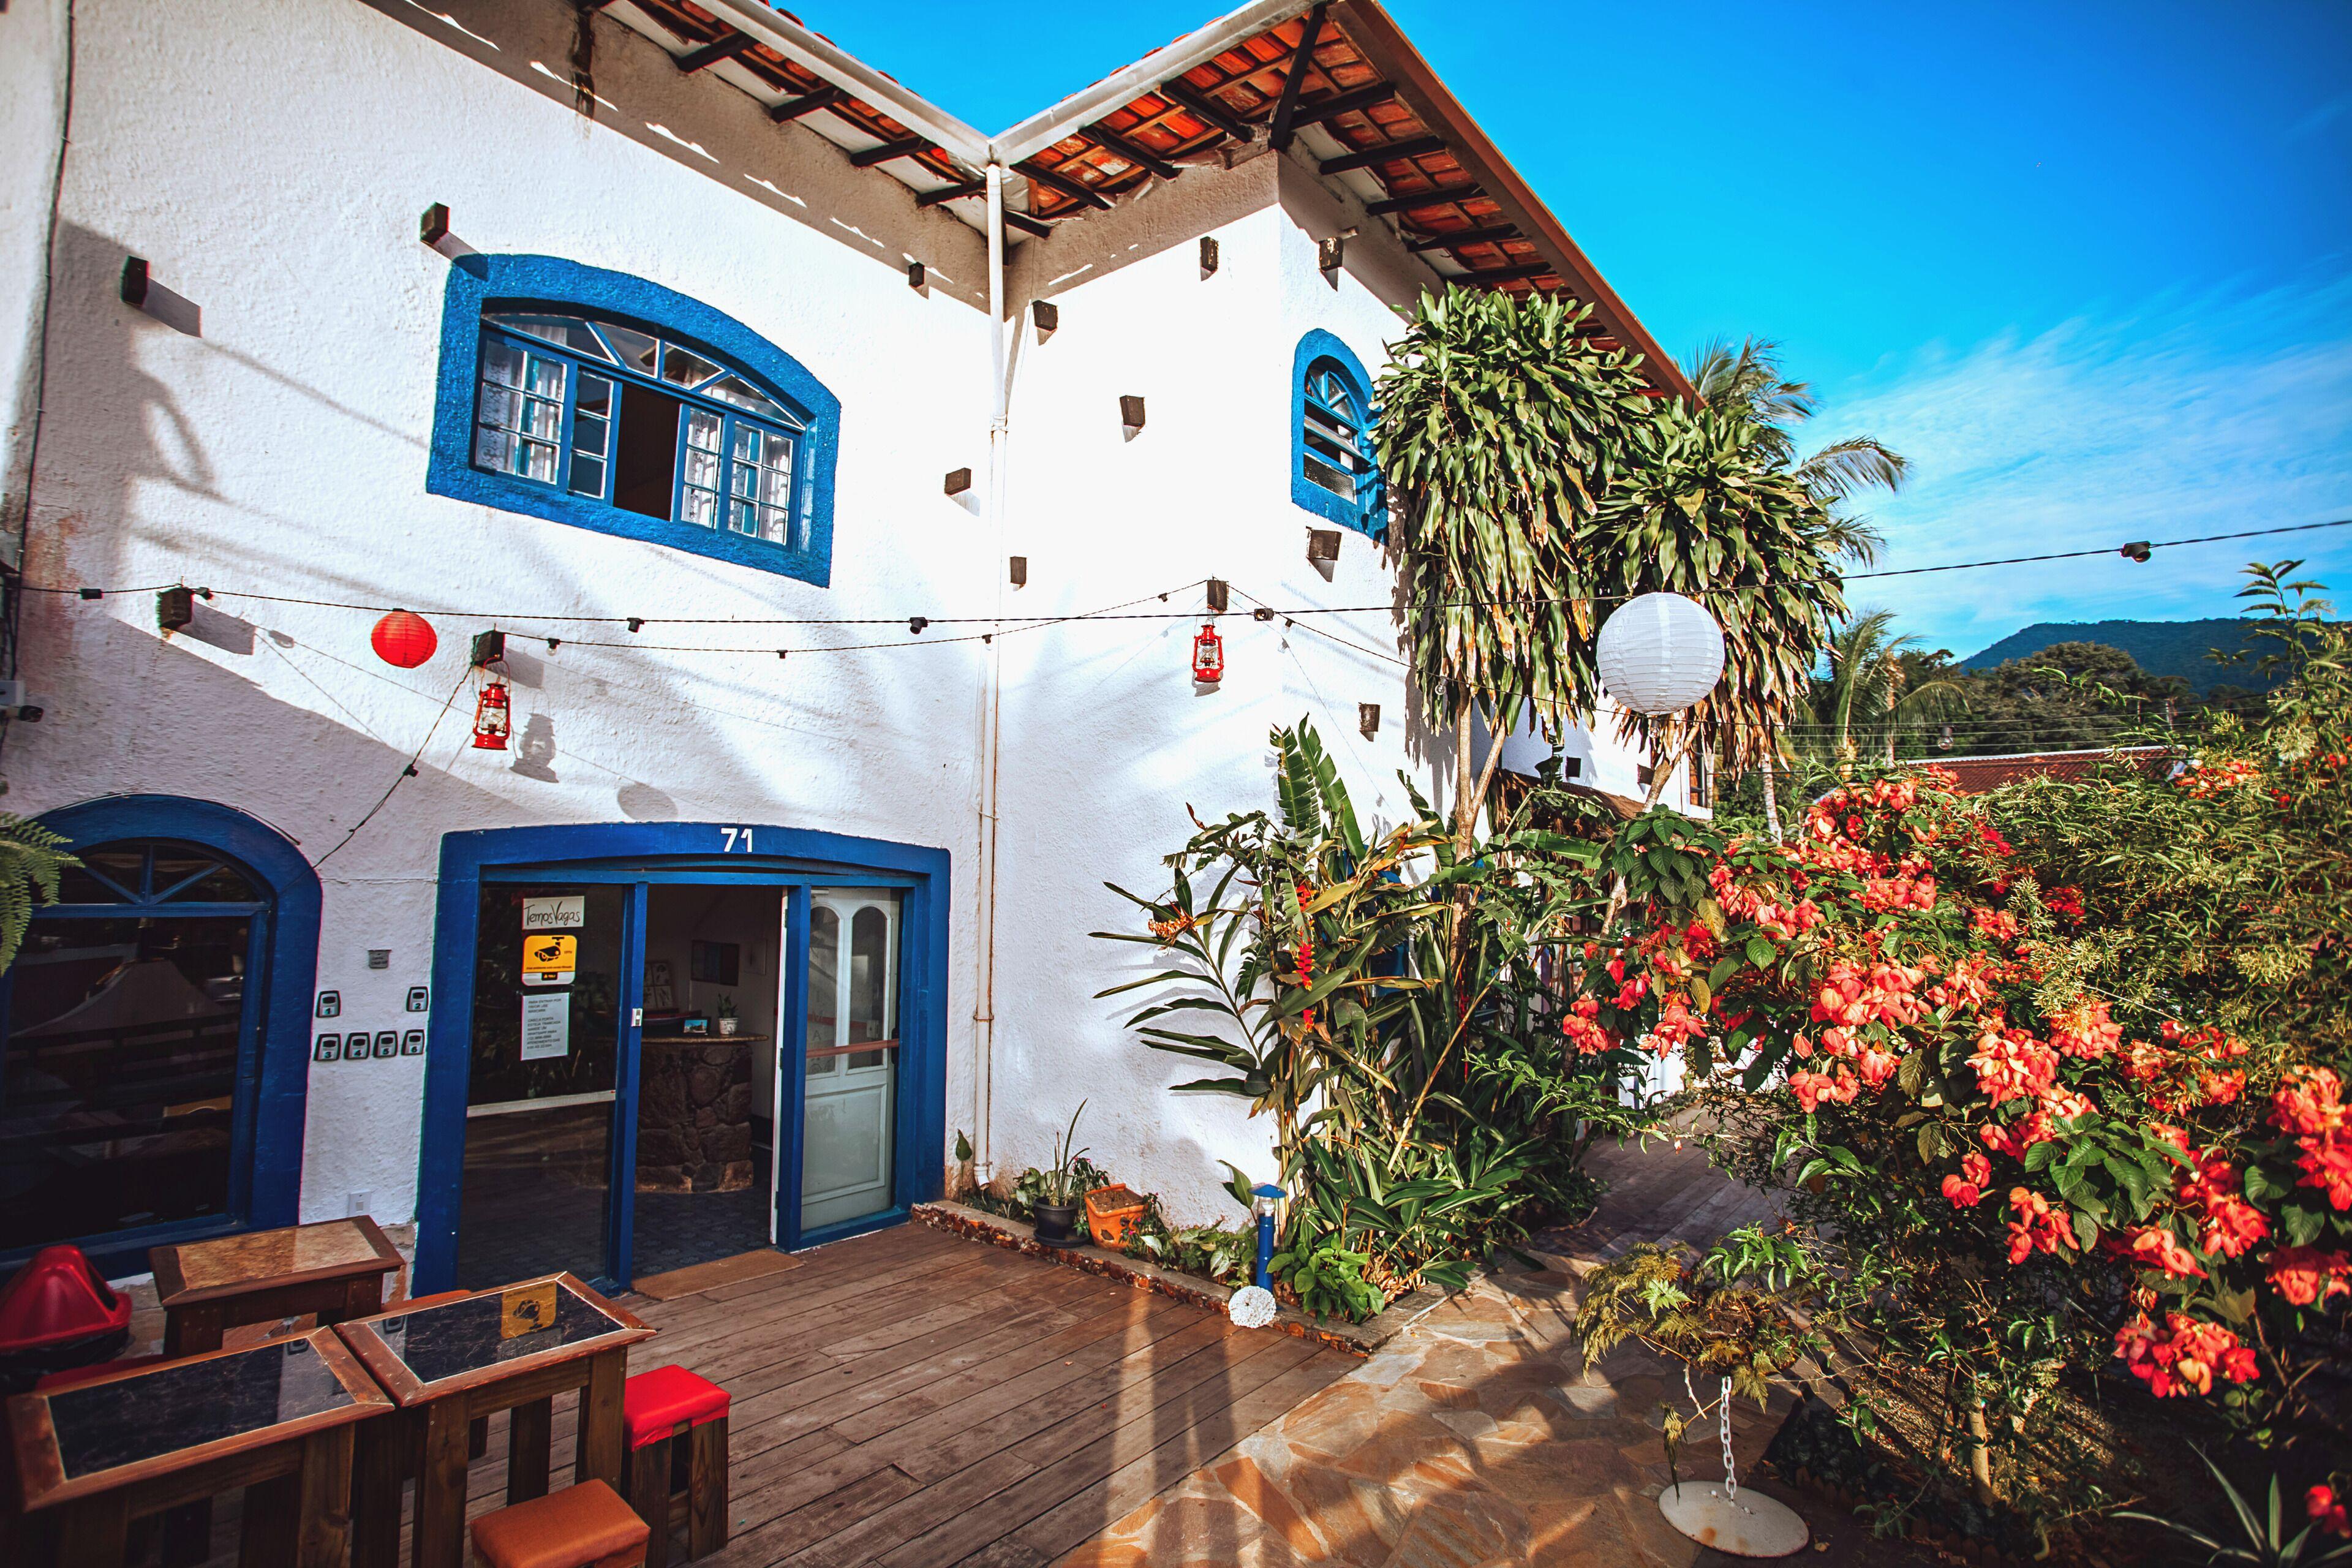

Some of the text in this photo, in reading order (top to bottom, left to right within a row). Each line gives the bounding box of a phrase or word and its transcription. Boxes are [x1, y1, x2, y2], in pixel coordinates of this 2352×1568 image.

[721, 827, 752, 853] 71
[524, 901, 581, 926] Temos Vagas
